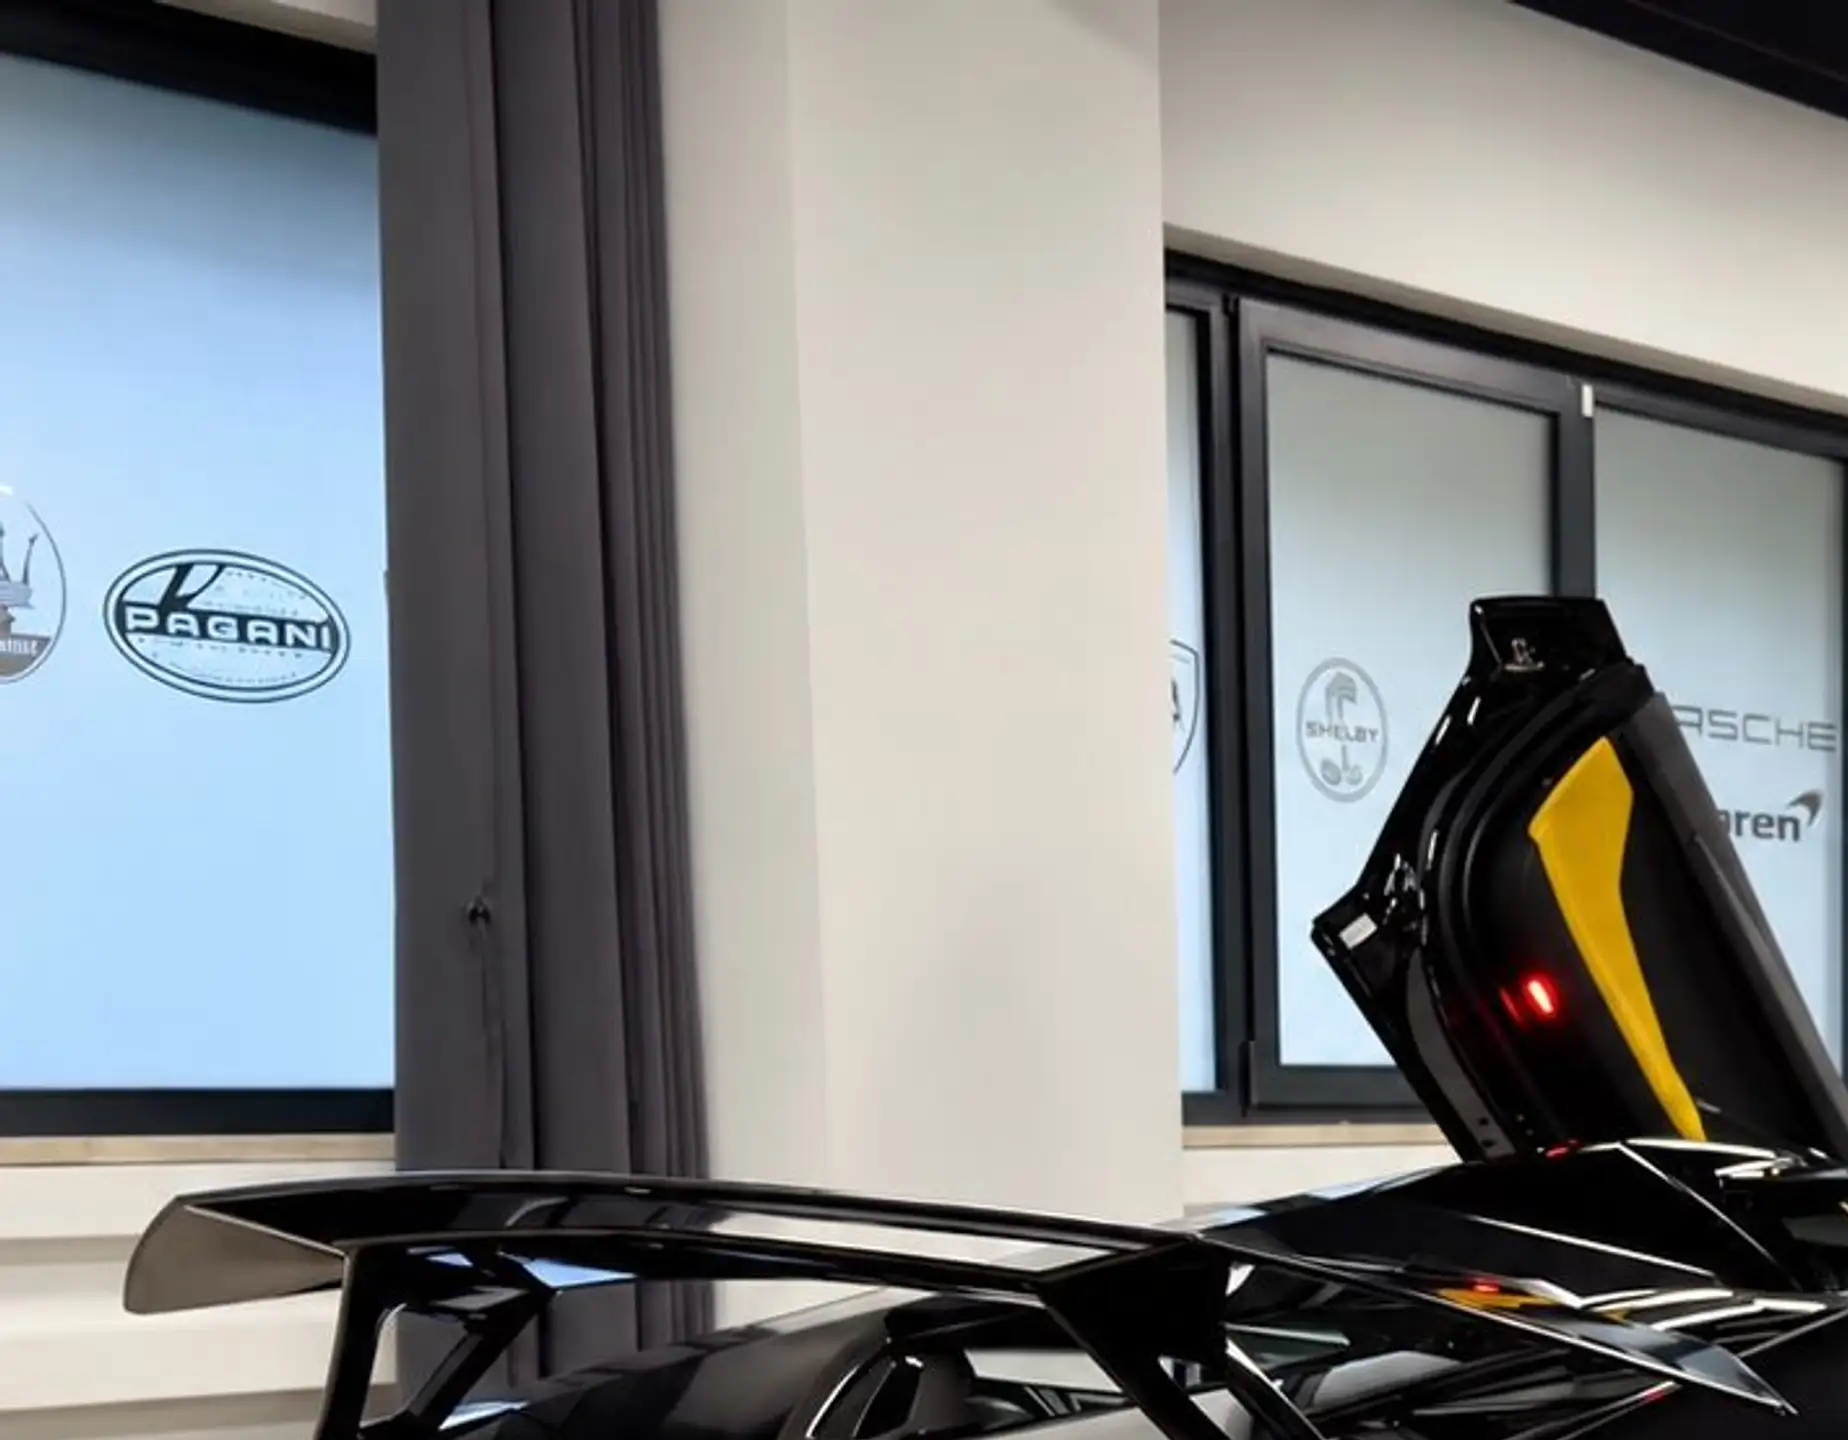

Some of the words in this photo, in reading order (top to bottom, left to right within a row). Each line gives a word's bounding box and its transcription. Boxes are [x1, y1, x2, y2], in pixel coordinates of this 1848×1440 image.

[124, 606, 331, 649] PAGANI
[1305, 719, 1379, 743] SHELBY
[1671, 704, 1837, 753] RSCHE
